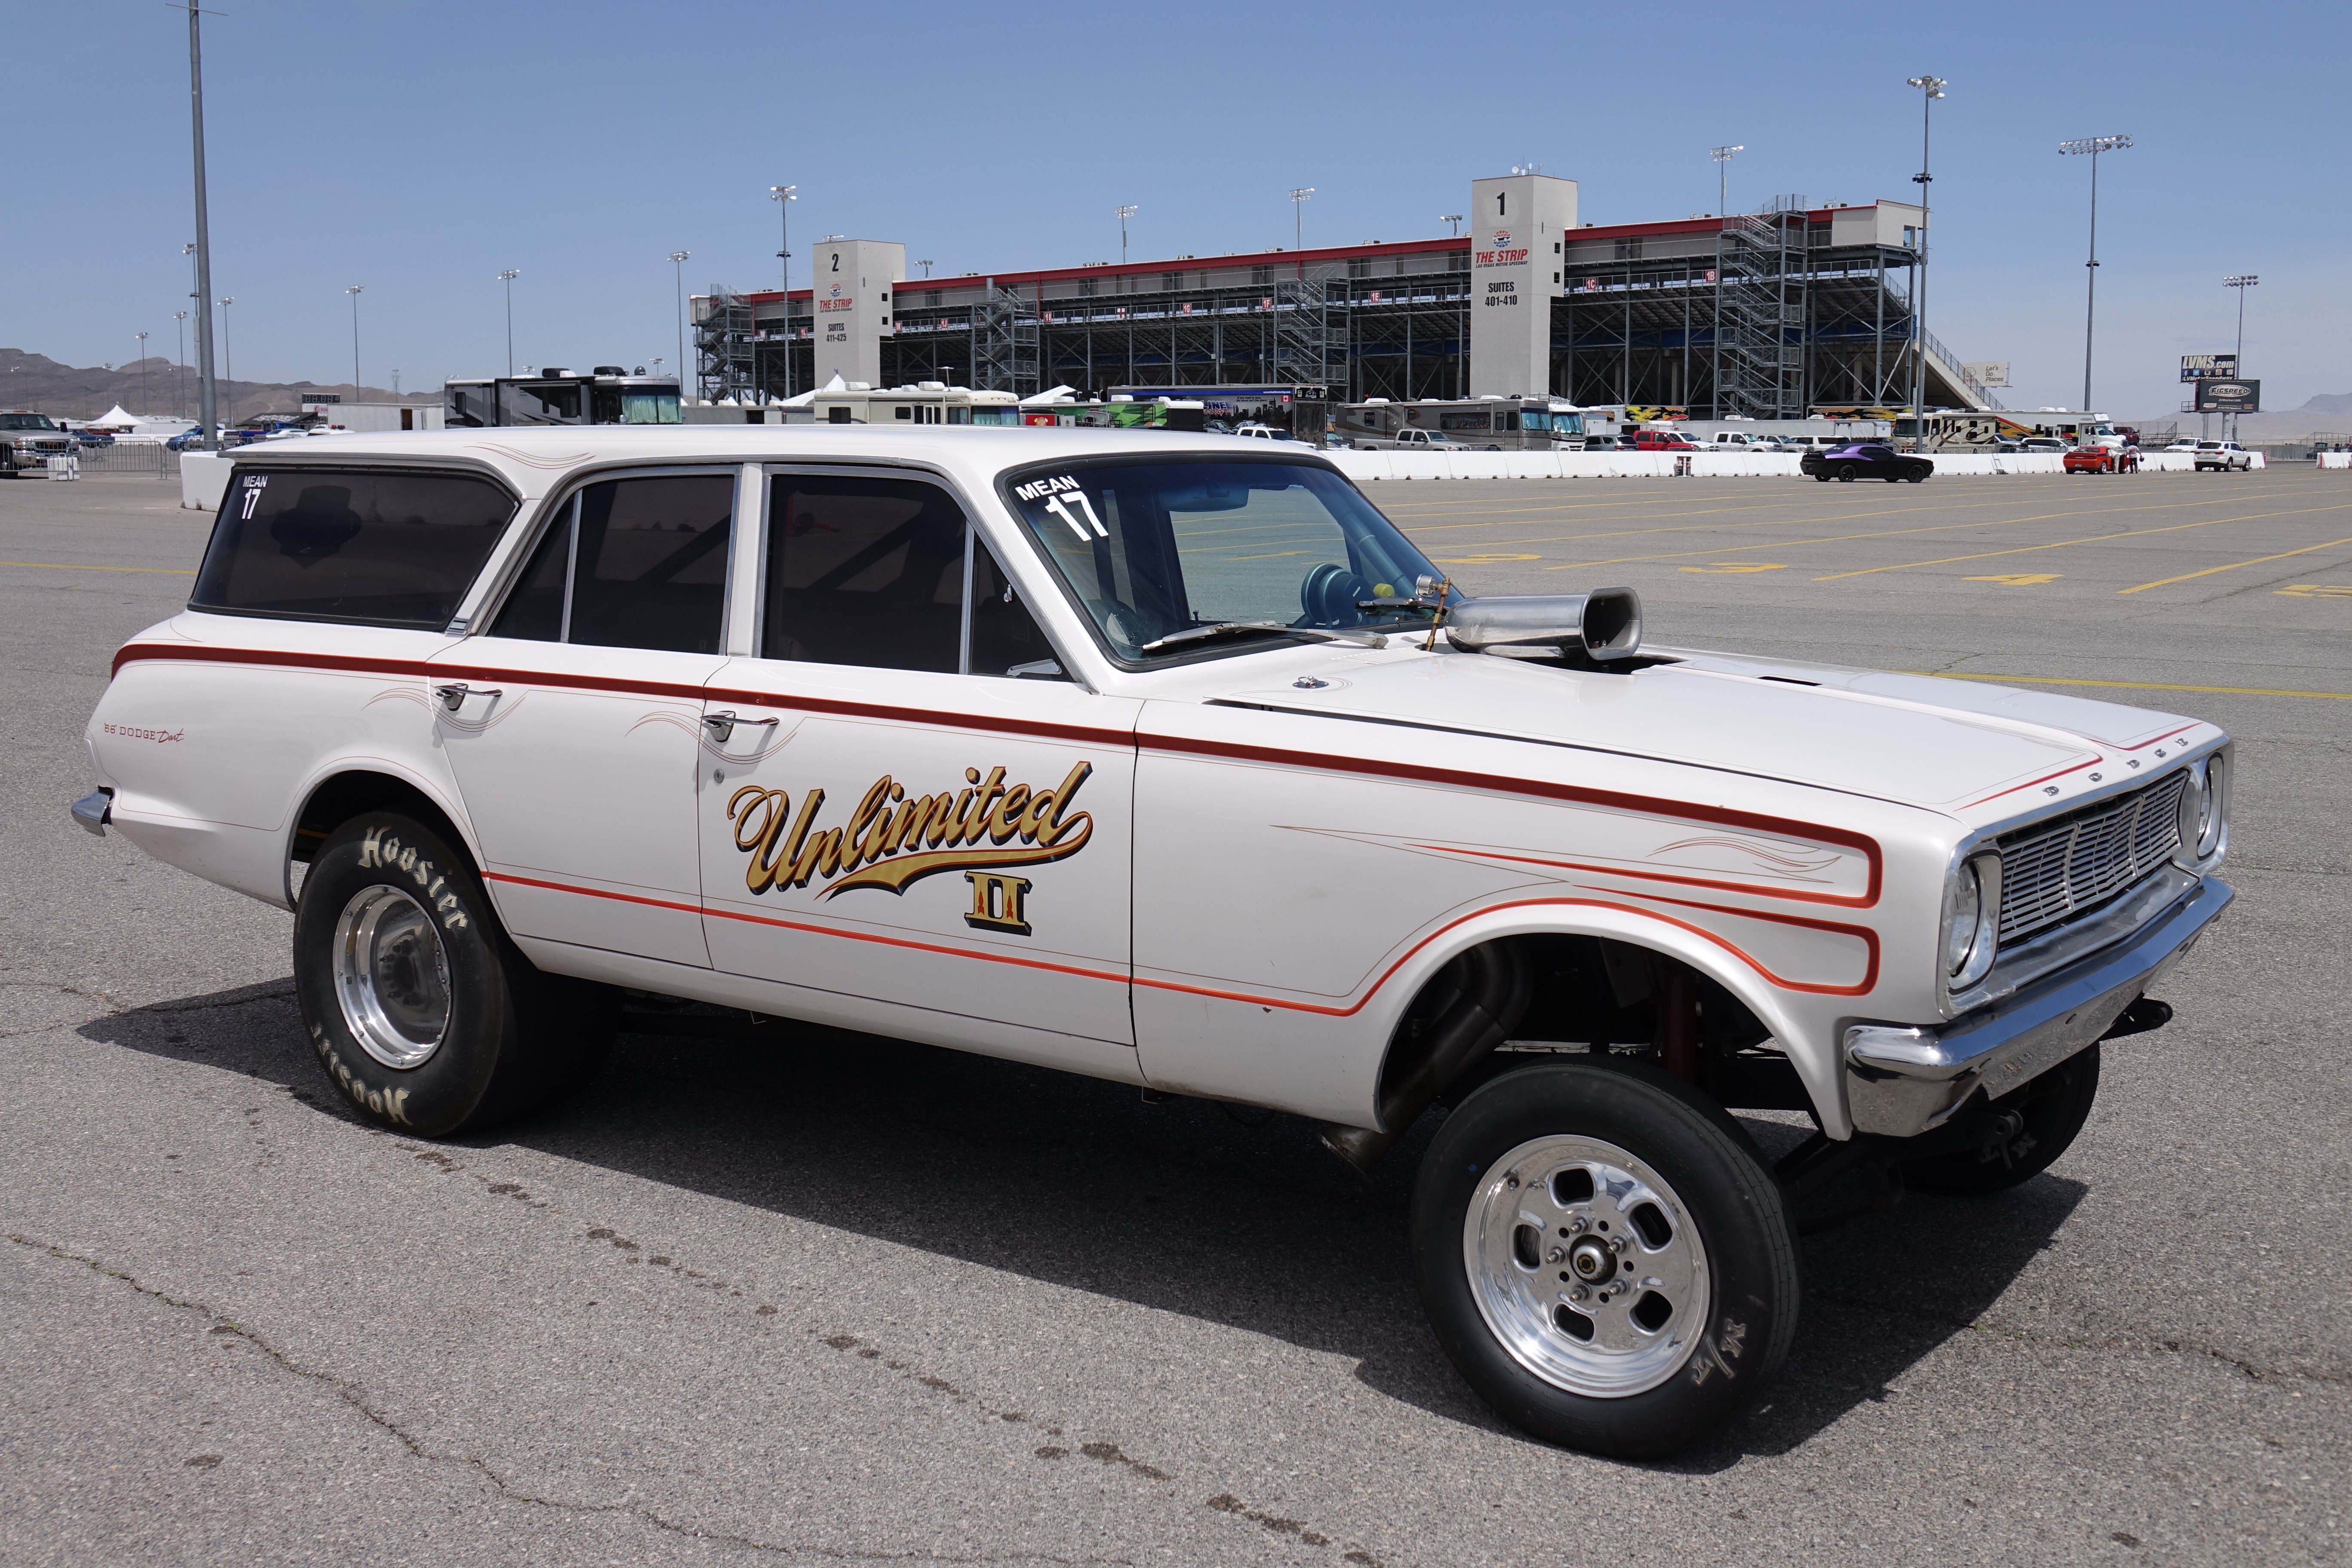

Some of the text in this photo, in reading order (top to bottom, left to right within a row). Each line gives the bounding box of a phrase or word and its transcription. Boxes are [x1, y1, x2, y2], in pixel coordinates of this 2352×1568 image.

[1497, 192, 1505, 215] 1
[832, 253, 839, 272] 2
[1475, 249, 1528, 263] THE STRIP
[1707, 271, 1715, 281] 1B
[1488, 282, 1514, 293] SUITES
[1587, 279, 1595, 289] 1C
[819, 298, 852, 309] THE STRIP
[1372, 292, 1379, 301] 1E
[1485, 294, 1518, 306] 401-410
[1184, 304, 1190, 313] 1G
[1263, 300, 1270, 308] 1F
[828, 323, 844, 332] SUITES
[826, 333, 847, 342] 411-425
[2182, 355, 2234, 369] LVMS.com
[243, 476, 268, 487] MEAN
[1015, 475, 1080, 501] MEAN
[242, 488, 261, 519] 17
[1045, 491, 1109, 541] 17
[119, 726, 156, 740] DODGE
[156, 728, 184, 743] Dart
[2042, 738, 2188, 796] DODGE
[727, 760, 1093, 896] Unlimited
[964, 871, 1033, 937] II
[1693, 1318, 1746, 1386] M/T
